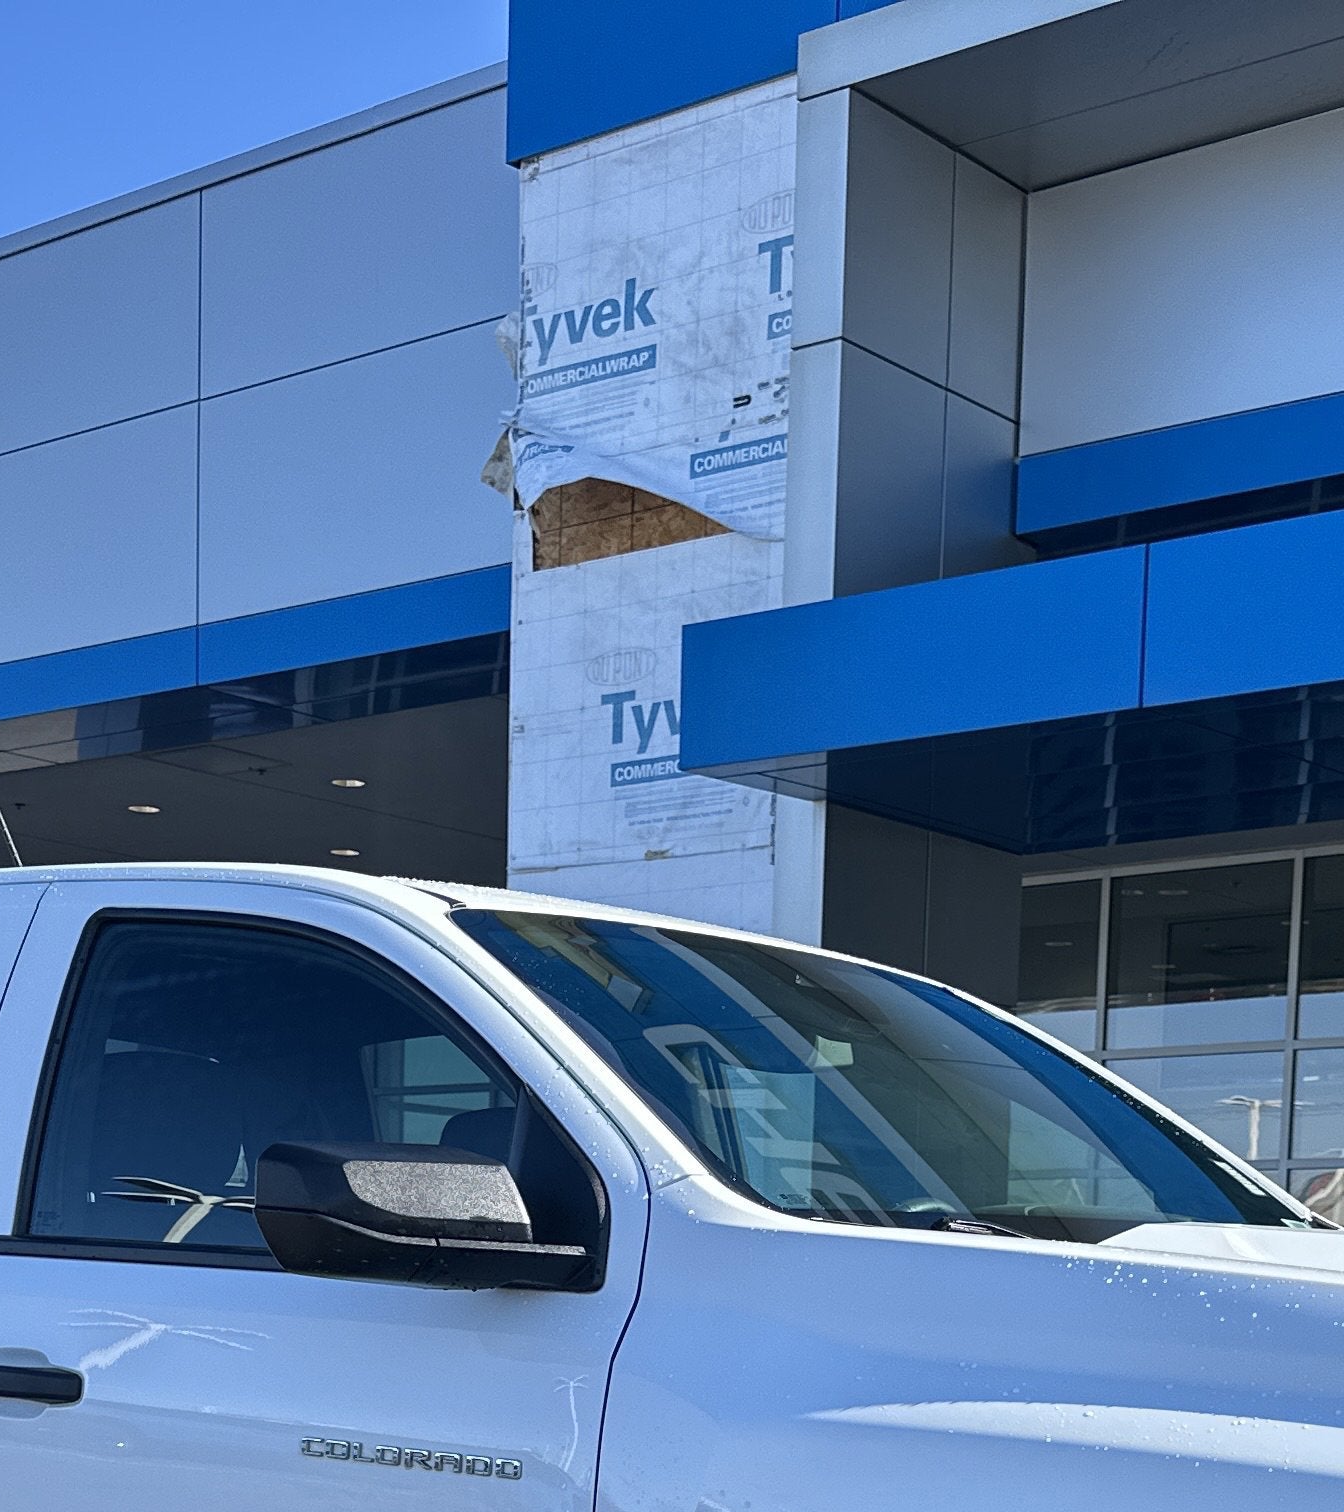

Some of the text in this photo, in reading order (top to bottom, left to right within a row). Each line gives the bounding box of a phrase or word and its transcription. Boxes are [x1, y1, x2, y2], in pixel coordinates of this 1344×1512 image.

[525, 277, 657, 366] yvek
[525, 351, 649, 394] OMMERCIALWRAP
[301, 1437, 523, 1480] COLORADO
